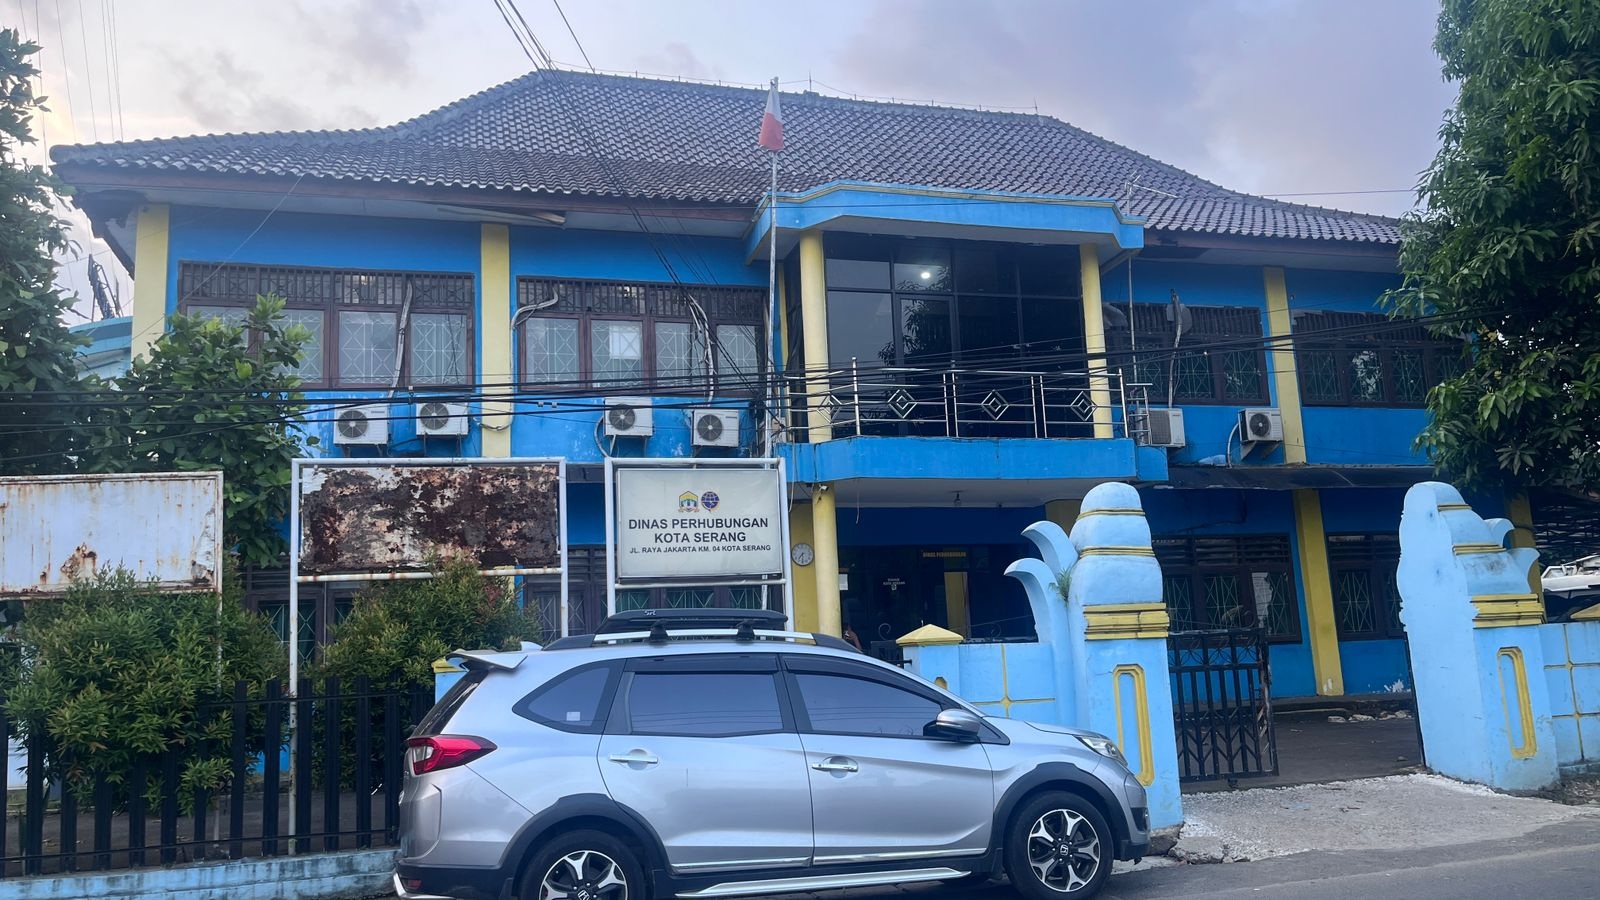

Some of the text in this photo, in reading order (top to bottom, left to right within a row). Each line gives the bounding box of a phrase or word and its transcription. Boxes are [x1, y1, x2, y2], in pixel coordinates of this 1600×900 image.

[629, 518, 768, 530] DINAS PERHUBUNGAN
[654, 532, 746, 543] KOTA SERANG
